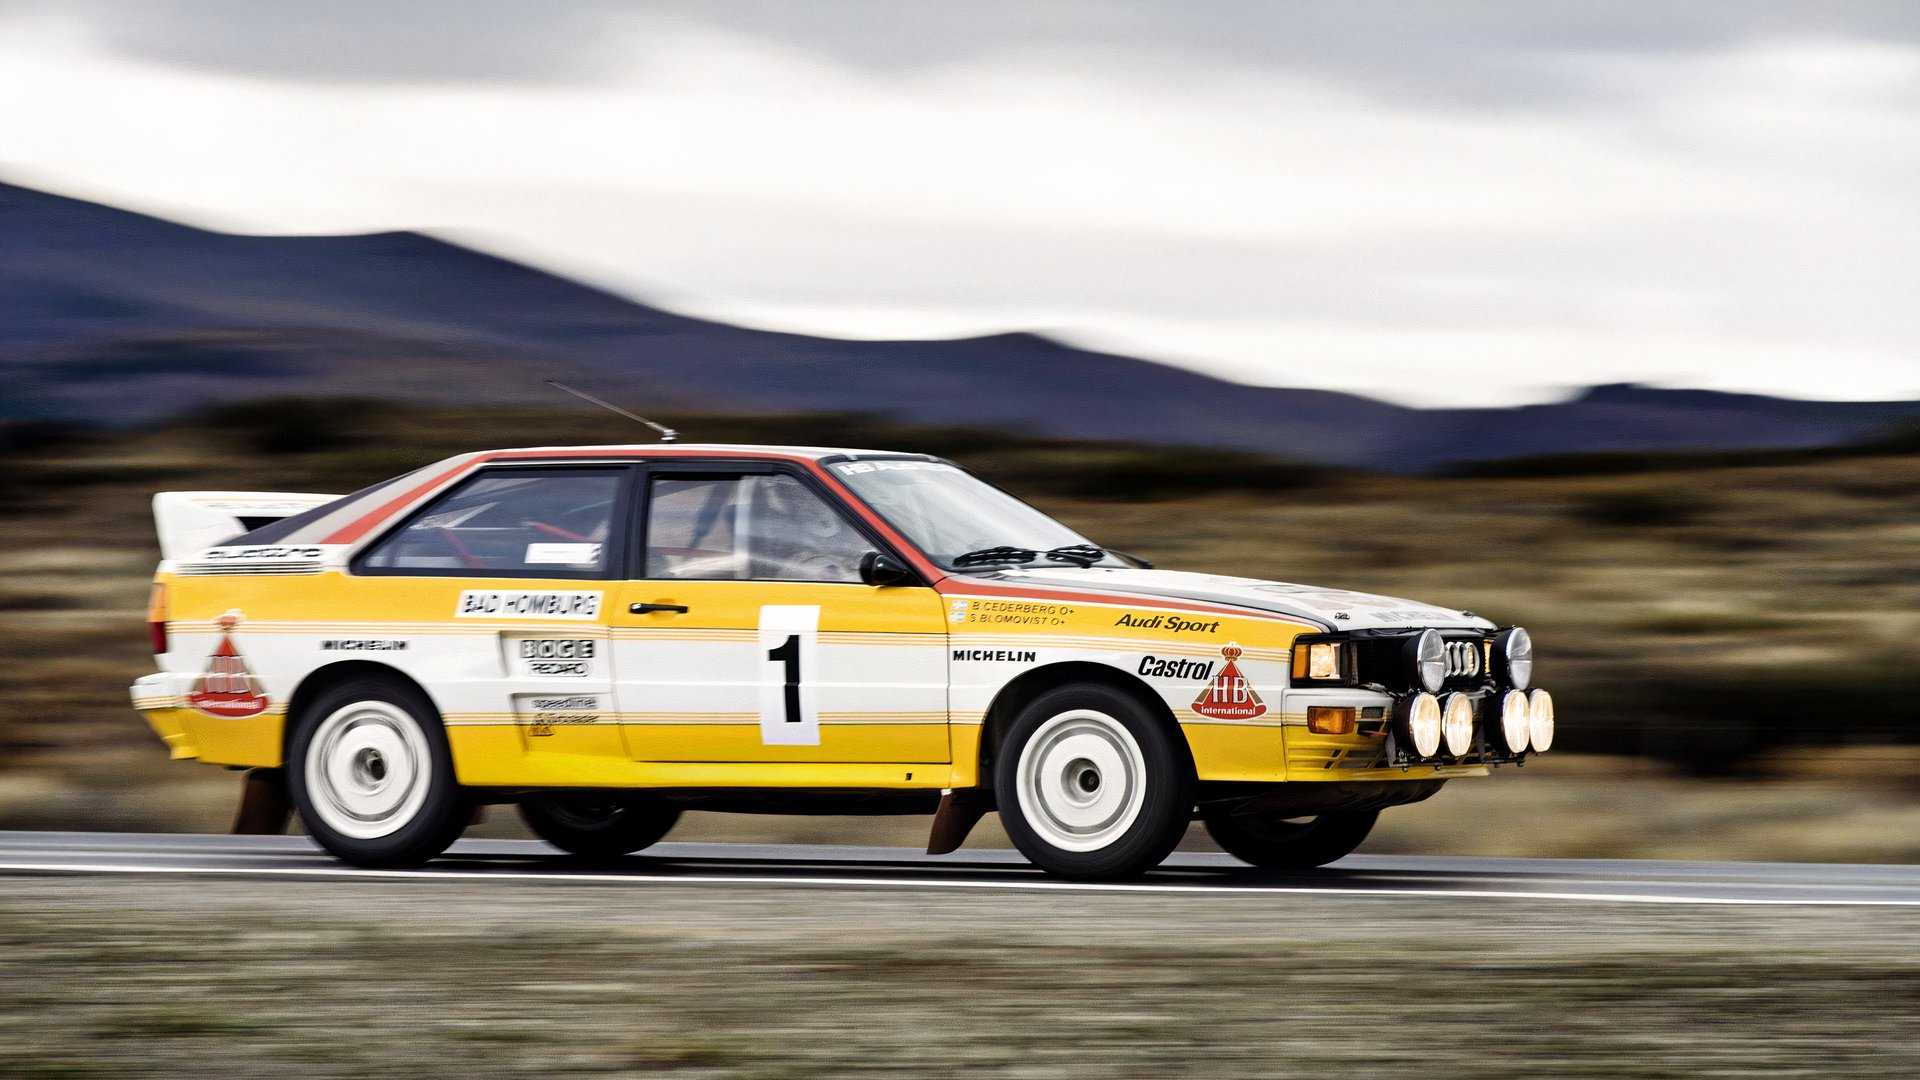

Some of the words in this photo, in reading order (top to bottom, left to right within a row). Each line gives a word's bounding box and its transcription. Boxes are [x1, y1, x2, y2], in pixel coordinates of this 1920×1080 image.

[464, 594, 500, 613] BAD
[1115, 613, 1163, 629] Audi
[1164, 616, 1221, 633] Sport
[521, 640, 595, 659] BOGE
[953, 650, 1036, 662] MICHELIN
[1138, 655, 1215, 681] Castrol
[768, 634, 802, 723] 1
[1212, 676, 1249, 704] HB
